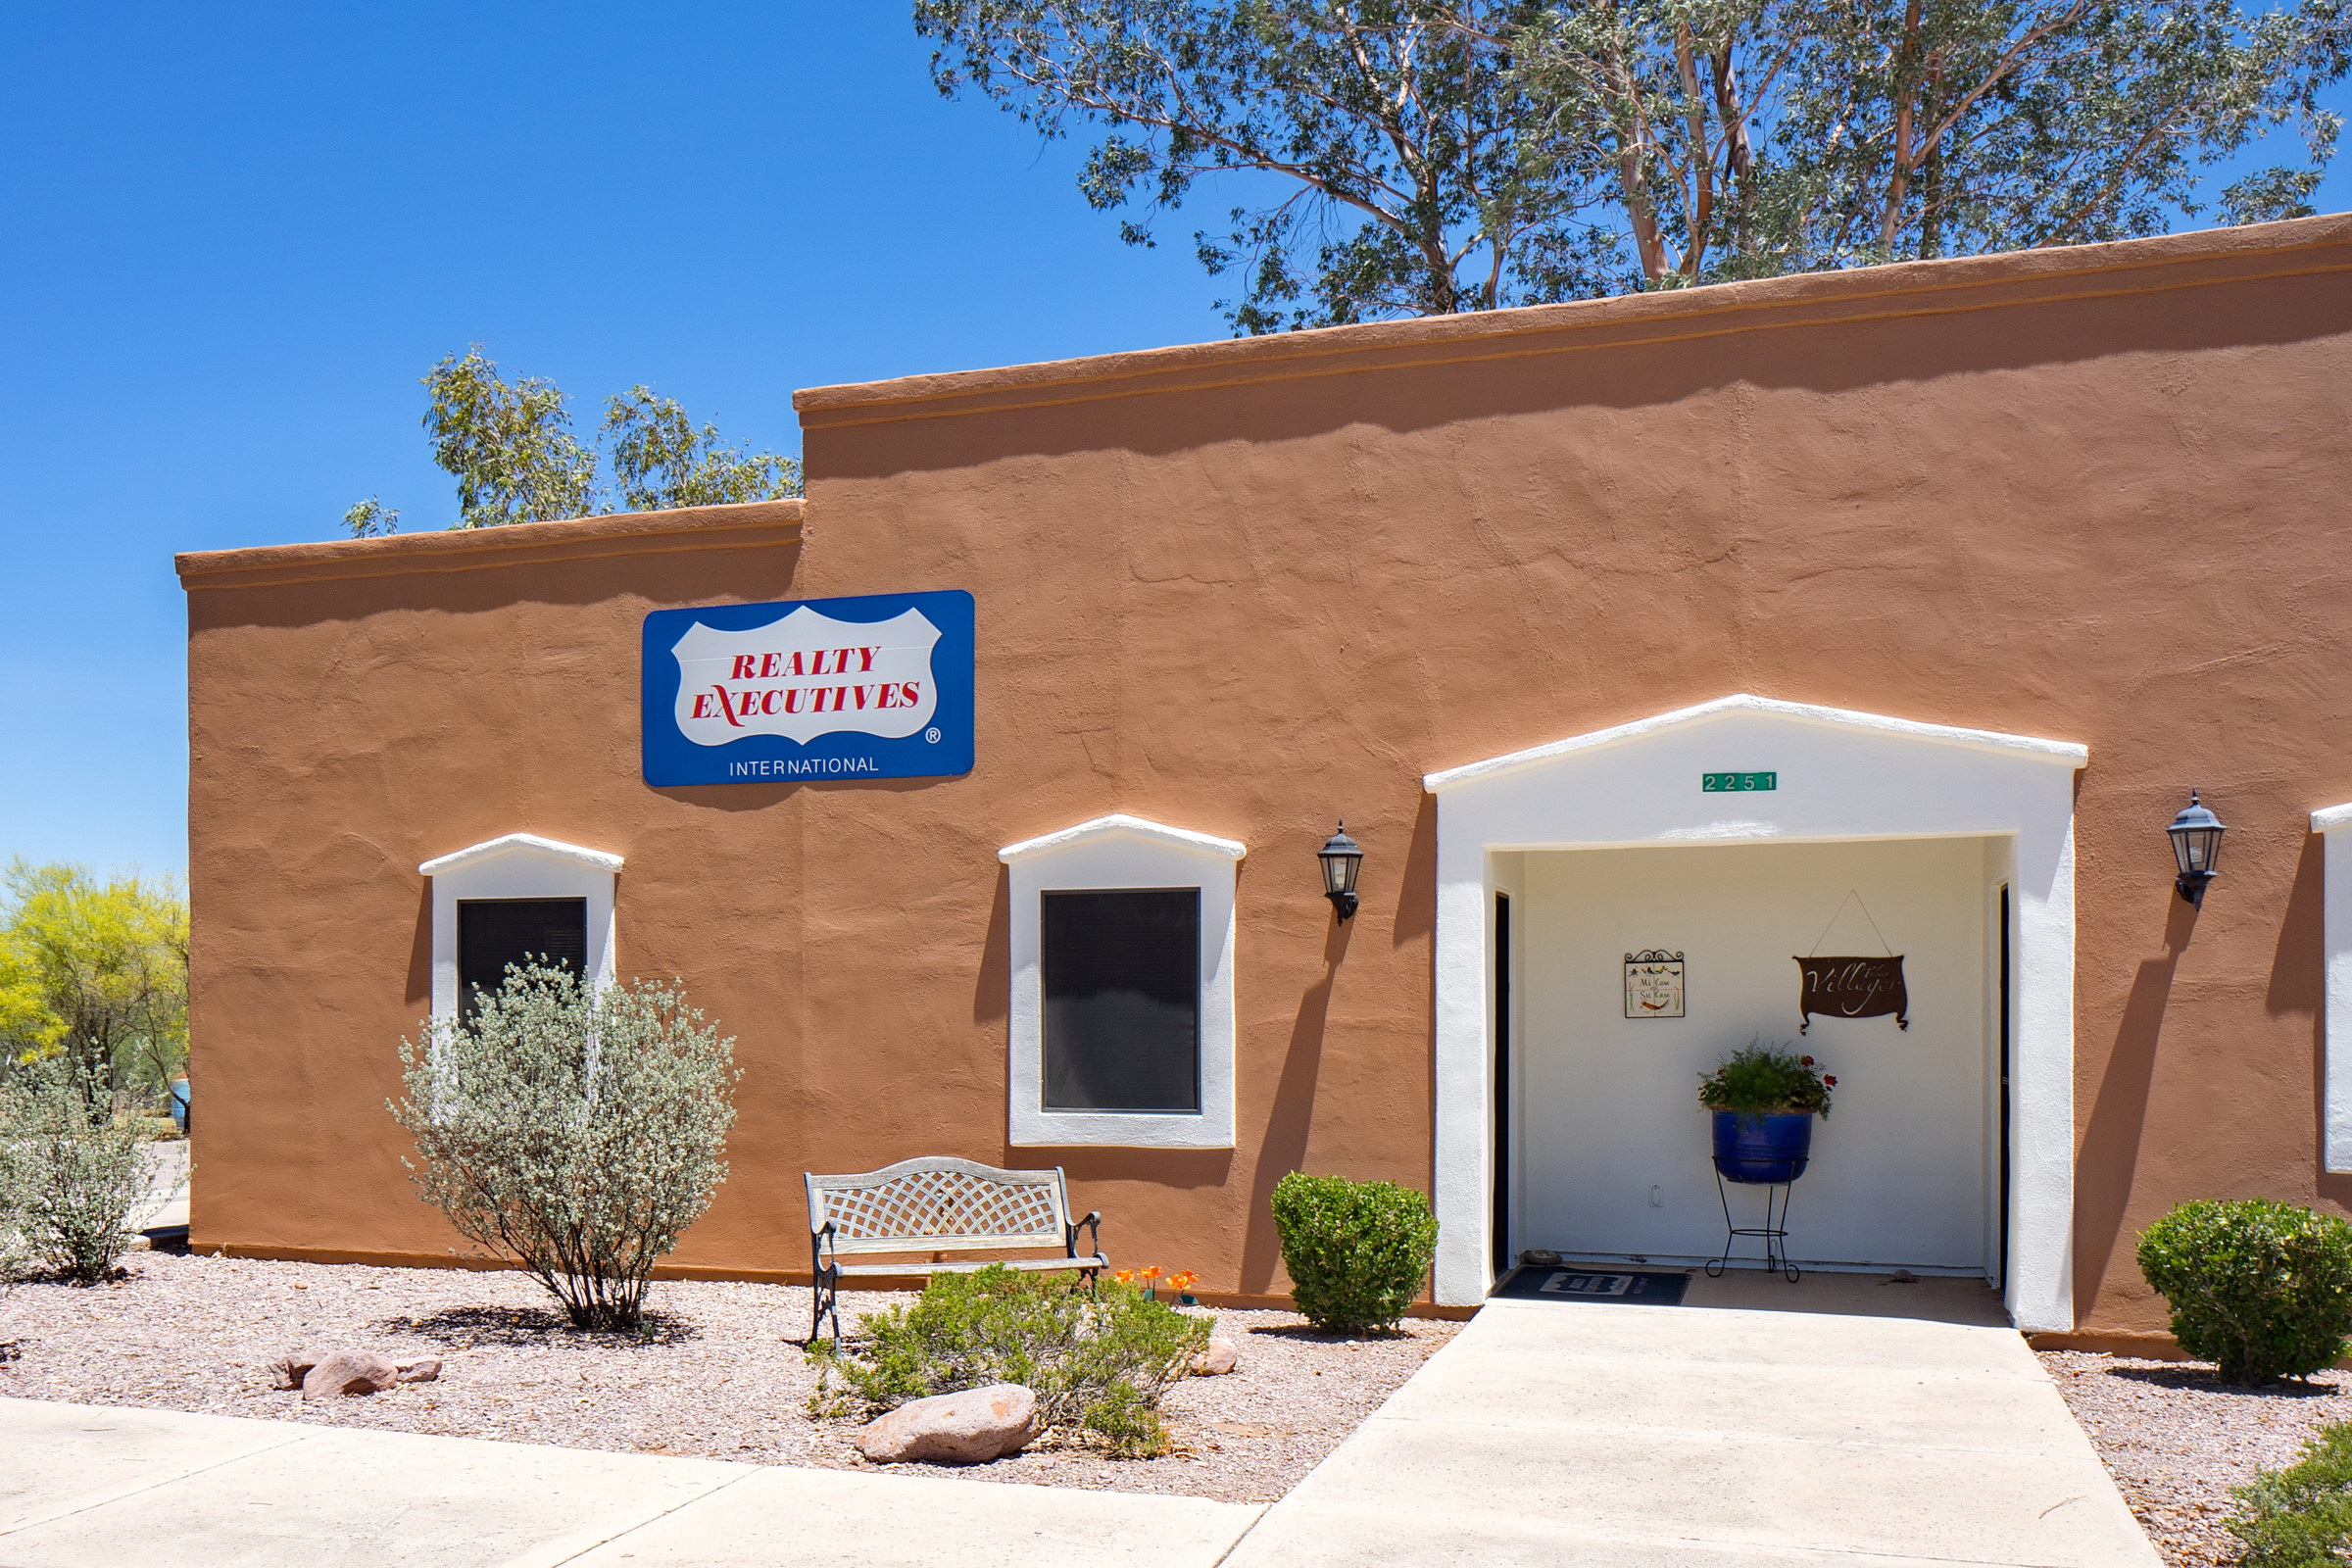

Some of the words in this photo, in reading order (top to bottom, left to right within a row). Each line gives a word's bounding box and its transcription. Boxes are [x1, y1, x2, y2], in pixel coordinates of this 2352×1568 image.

[728, 646, 881, 680] REALTY
[690, 681, 920, 727] EXECUTIVES
[729, 757, 879, 776] INTERNATIONAL
[1640, 978, 1651, 987] Mi
[1640, 991, 1651, 1000] Su
